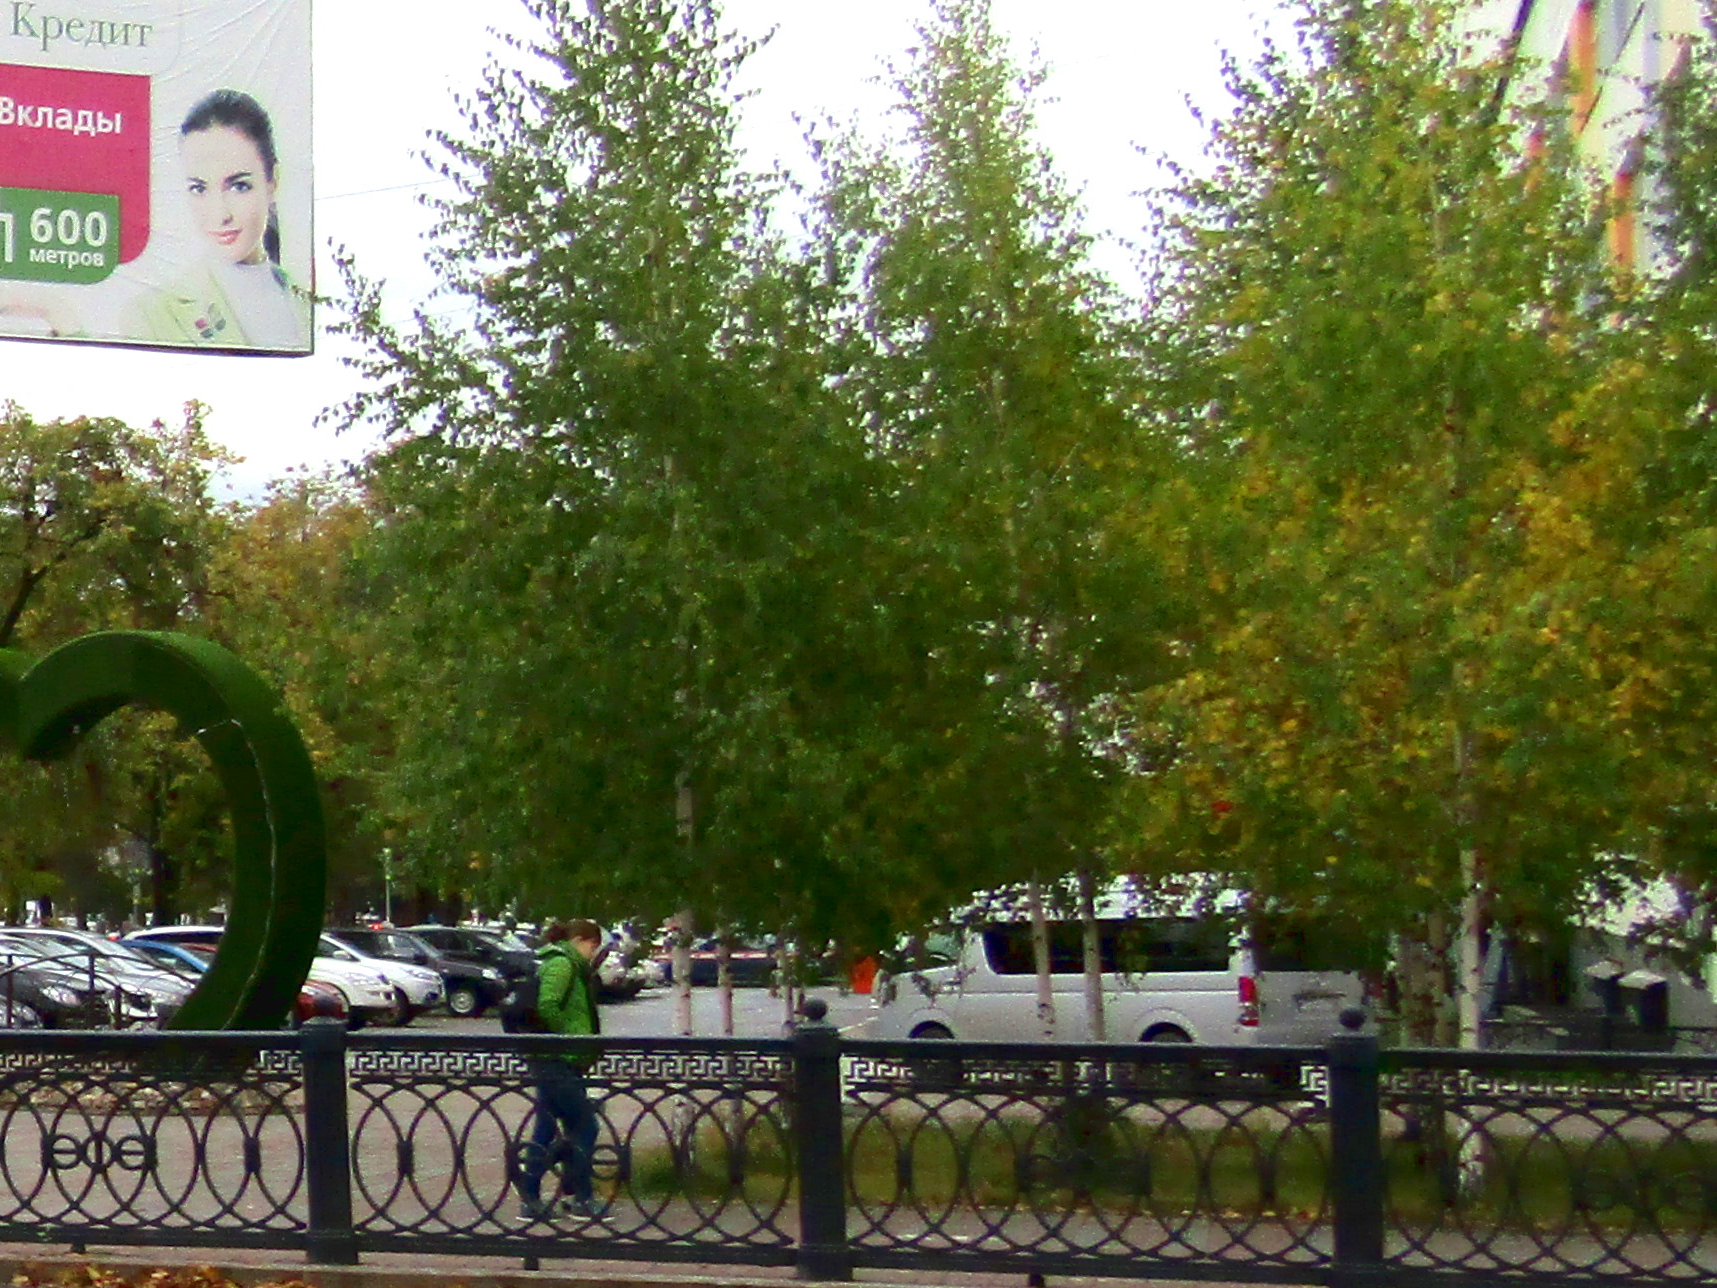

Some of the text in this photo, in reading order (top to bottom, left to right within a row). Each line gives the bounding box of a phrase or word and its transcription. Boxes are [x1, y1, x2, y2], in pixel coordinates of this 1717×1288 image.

[9, 1, 153, 50] Кредит
[30, 207, 107, 247] 600
[29, 248, 104, 269] метров
